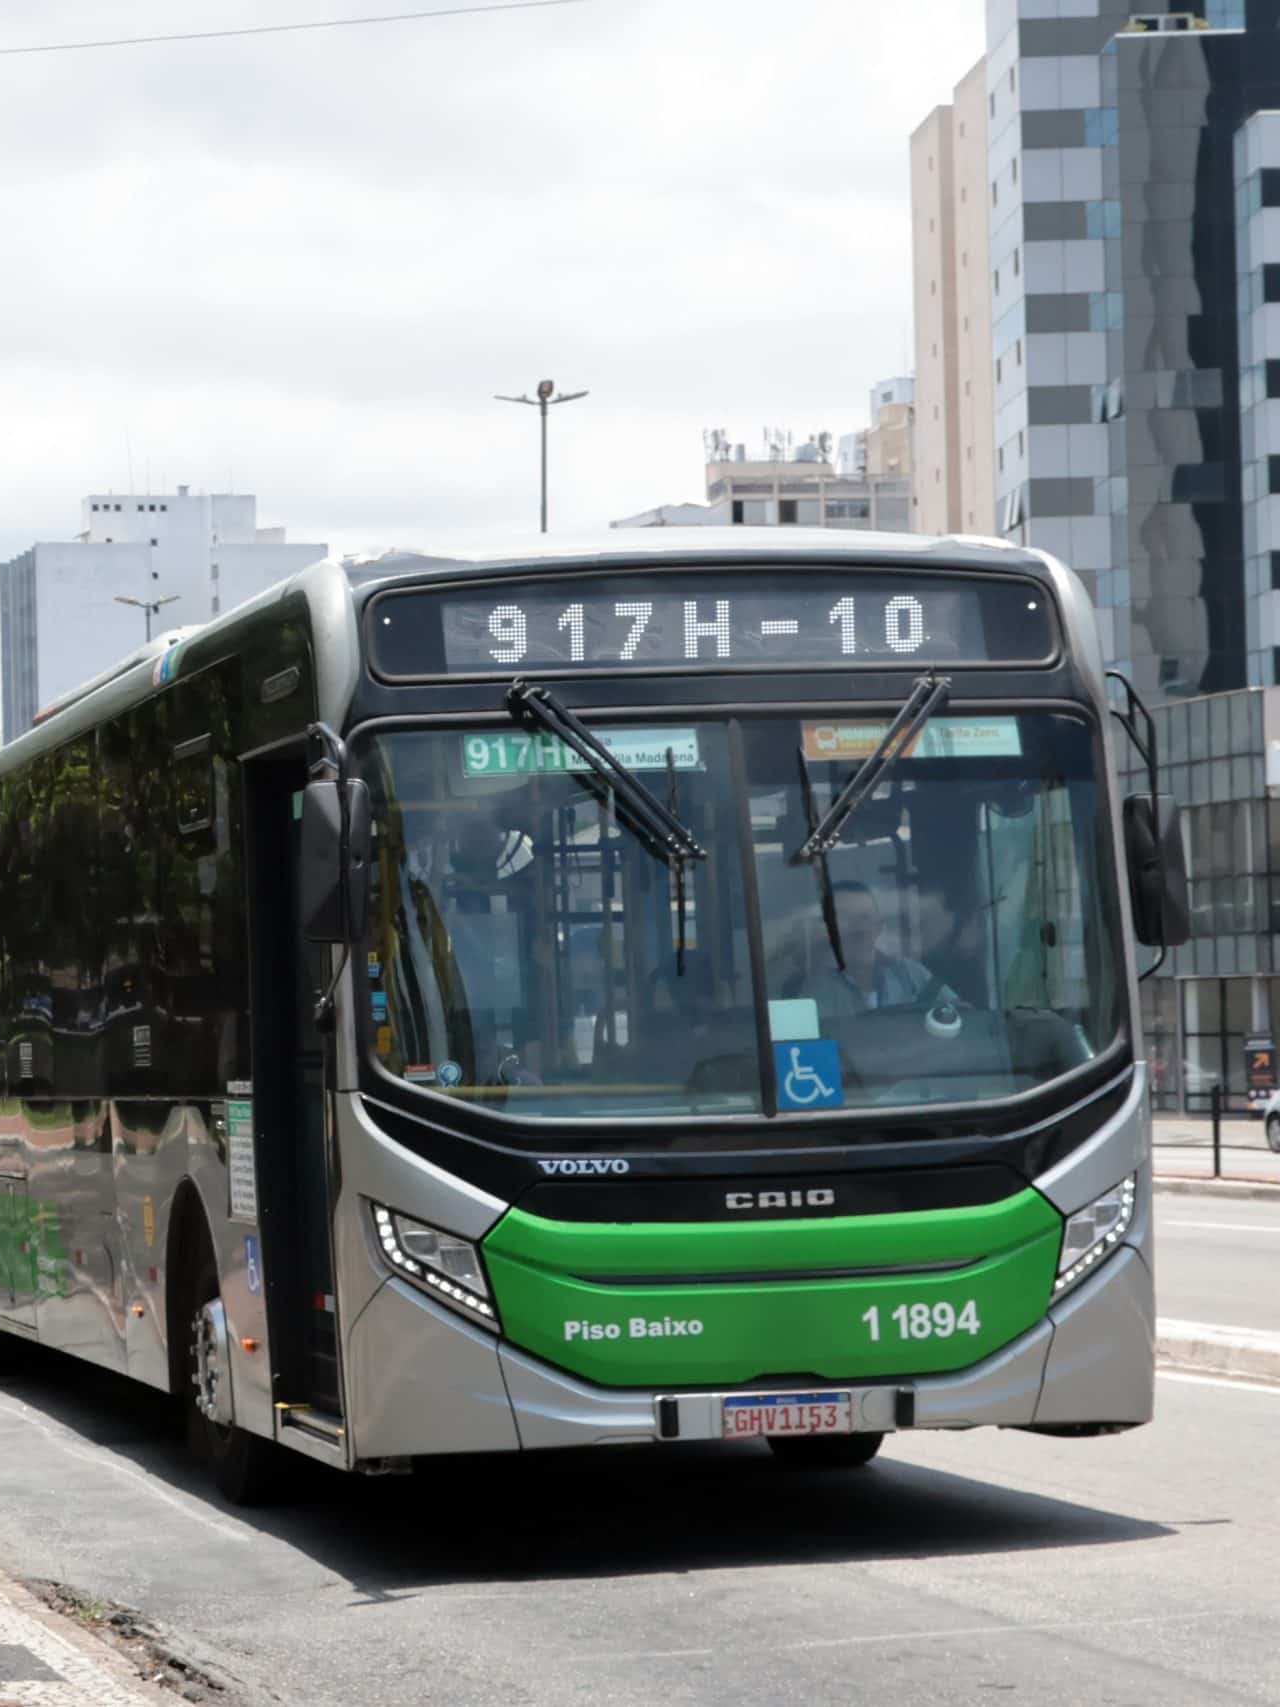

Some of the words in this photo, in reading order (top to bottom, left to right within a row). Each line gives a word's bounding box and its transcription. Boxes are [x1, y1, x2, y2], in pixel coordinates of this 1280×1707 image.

[488, 595, 924, 663] 917H-10
[635, 751, 695, 764] Madaena
[538, 1159, 630, 1175] VOLVO
[726, 1189, 835, 1209] CAIO
[564, 1320, 621, 1341] Piso
[628, 1316, 704, 1338] Baixo
[735, 1405, 837, 1432] GHV1I53
